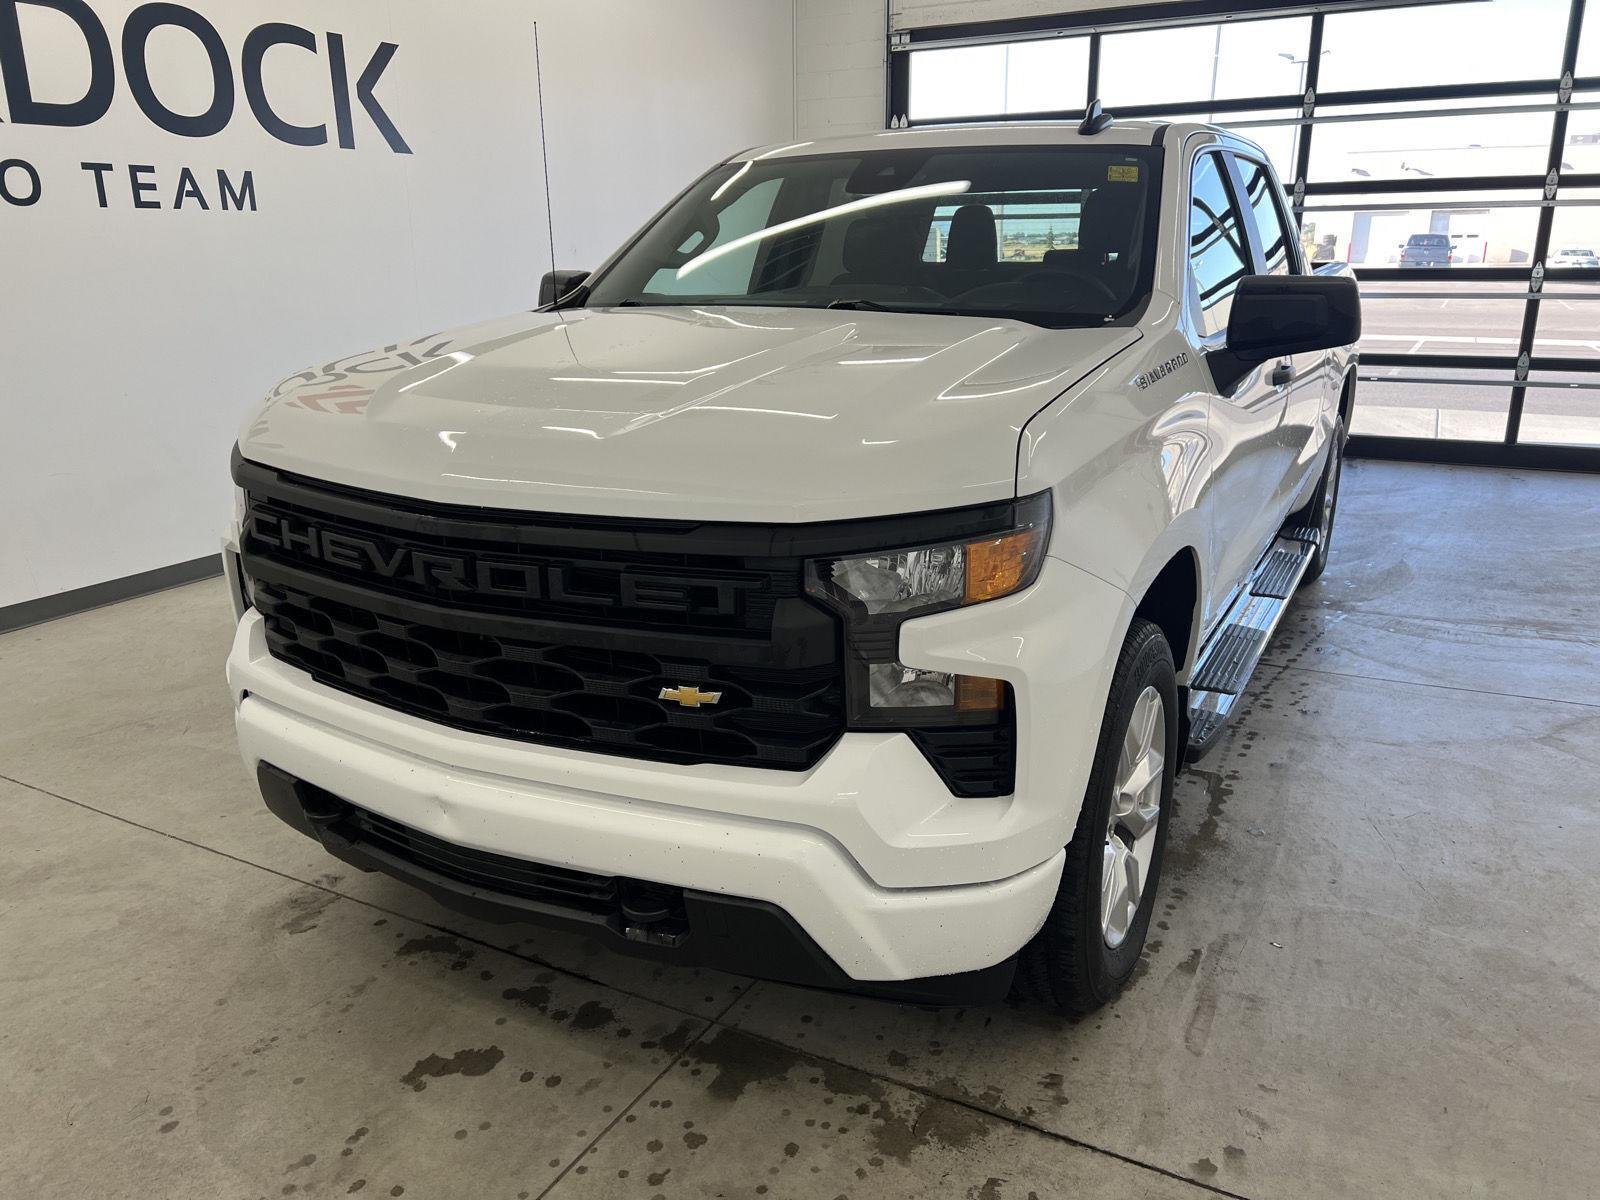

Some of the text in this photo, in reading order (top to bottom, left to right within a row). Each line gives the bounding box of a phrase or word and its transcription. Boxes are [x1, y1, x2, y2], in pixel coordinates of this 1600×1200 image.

[0, 0, 414, 154] DOCK
[80, 161, 258, 212] TEAM
[248, 508, 768, 616] CHEVROLET
